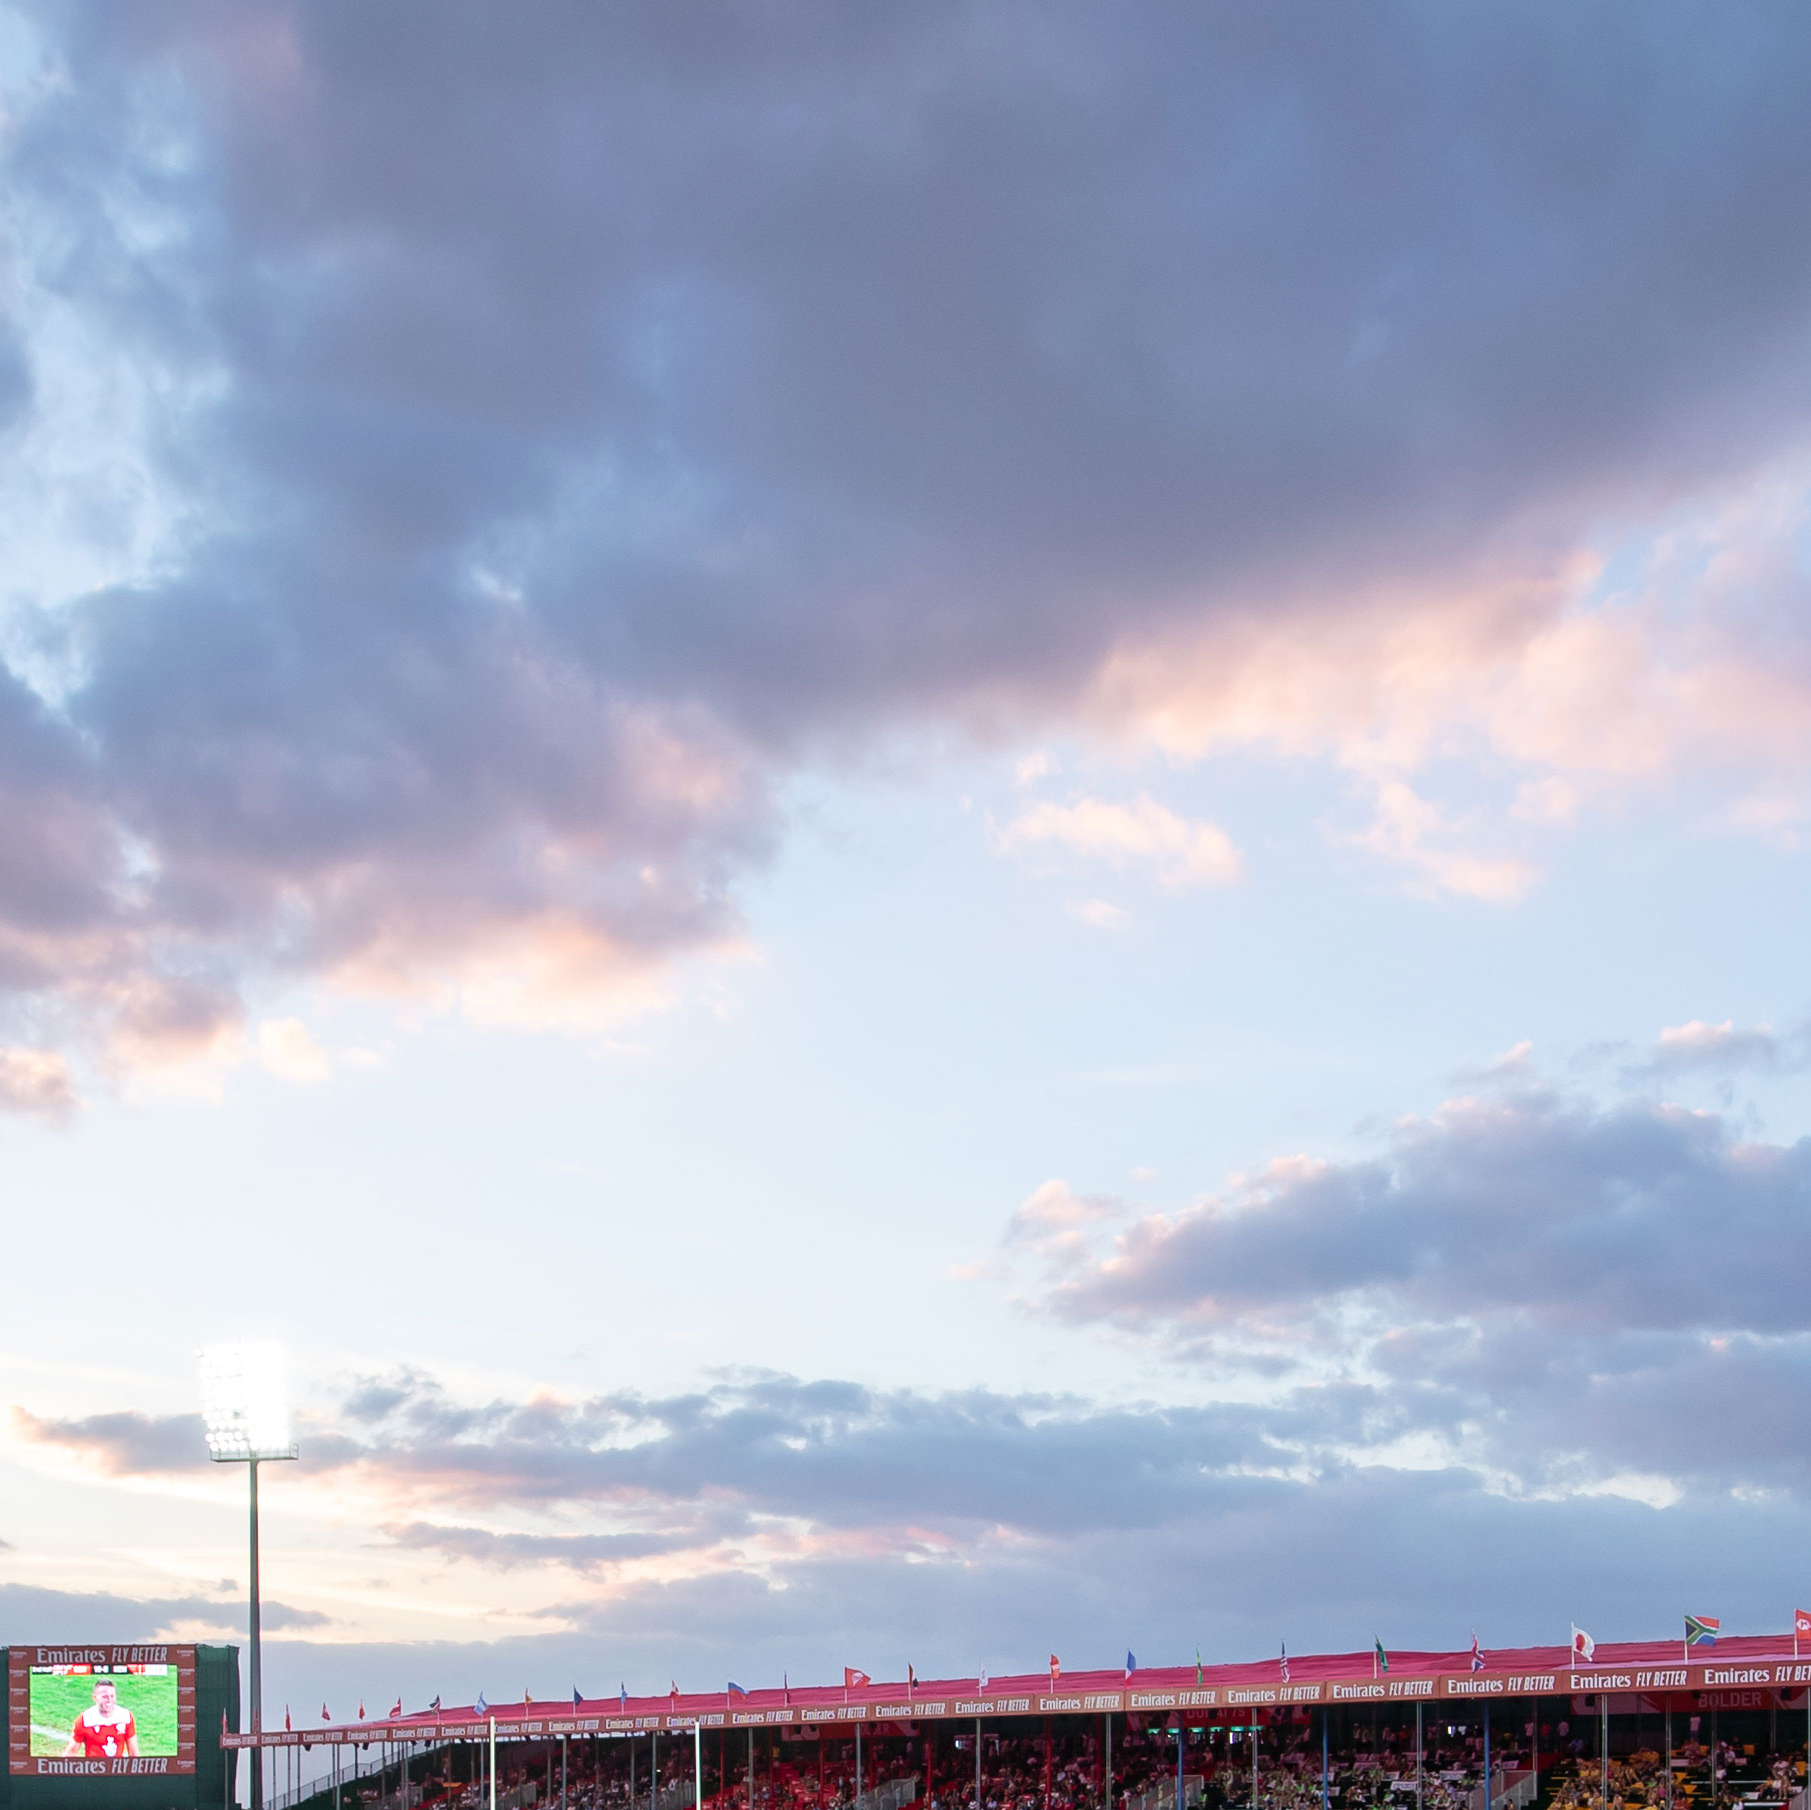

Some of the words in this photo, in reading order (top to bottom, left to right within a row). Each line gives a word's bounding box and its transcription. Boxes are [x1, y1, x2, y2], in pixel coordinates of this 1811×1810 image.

[37, 1647, 105, 1664] Emirates
[111, 1648, 130, 1663] FLY
[131, 1647, 168, 1662] BETTER
[1571, 1673, 1631, 1690] Emirates
[1636, 1672, 1652, 1687] FLY
[1653, 1671, 1687, 1685] BETTER
[1704, 1668, 1770, 1684] Emirates
[1775, 1666, 1793, 1682] FLY
[1448, 1678, 1503, 1694] Emirates
[1508, 1677, 1523, 1691] FLY
[1524, 1676, 1555, 1690] BETTER
[37, 1758, 105, 1774] Emirates
[111, 1759, 130, 1774] FLY
[131, 1758, 168, 1773] BETTER
